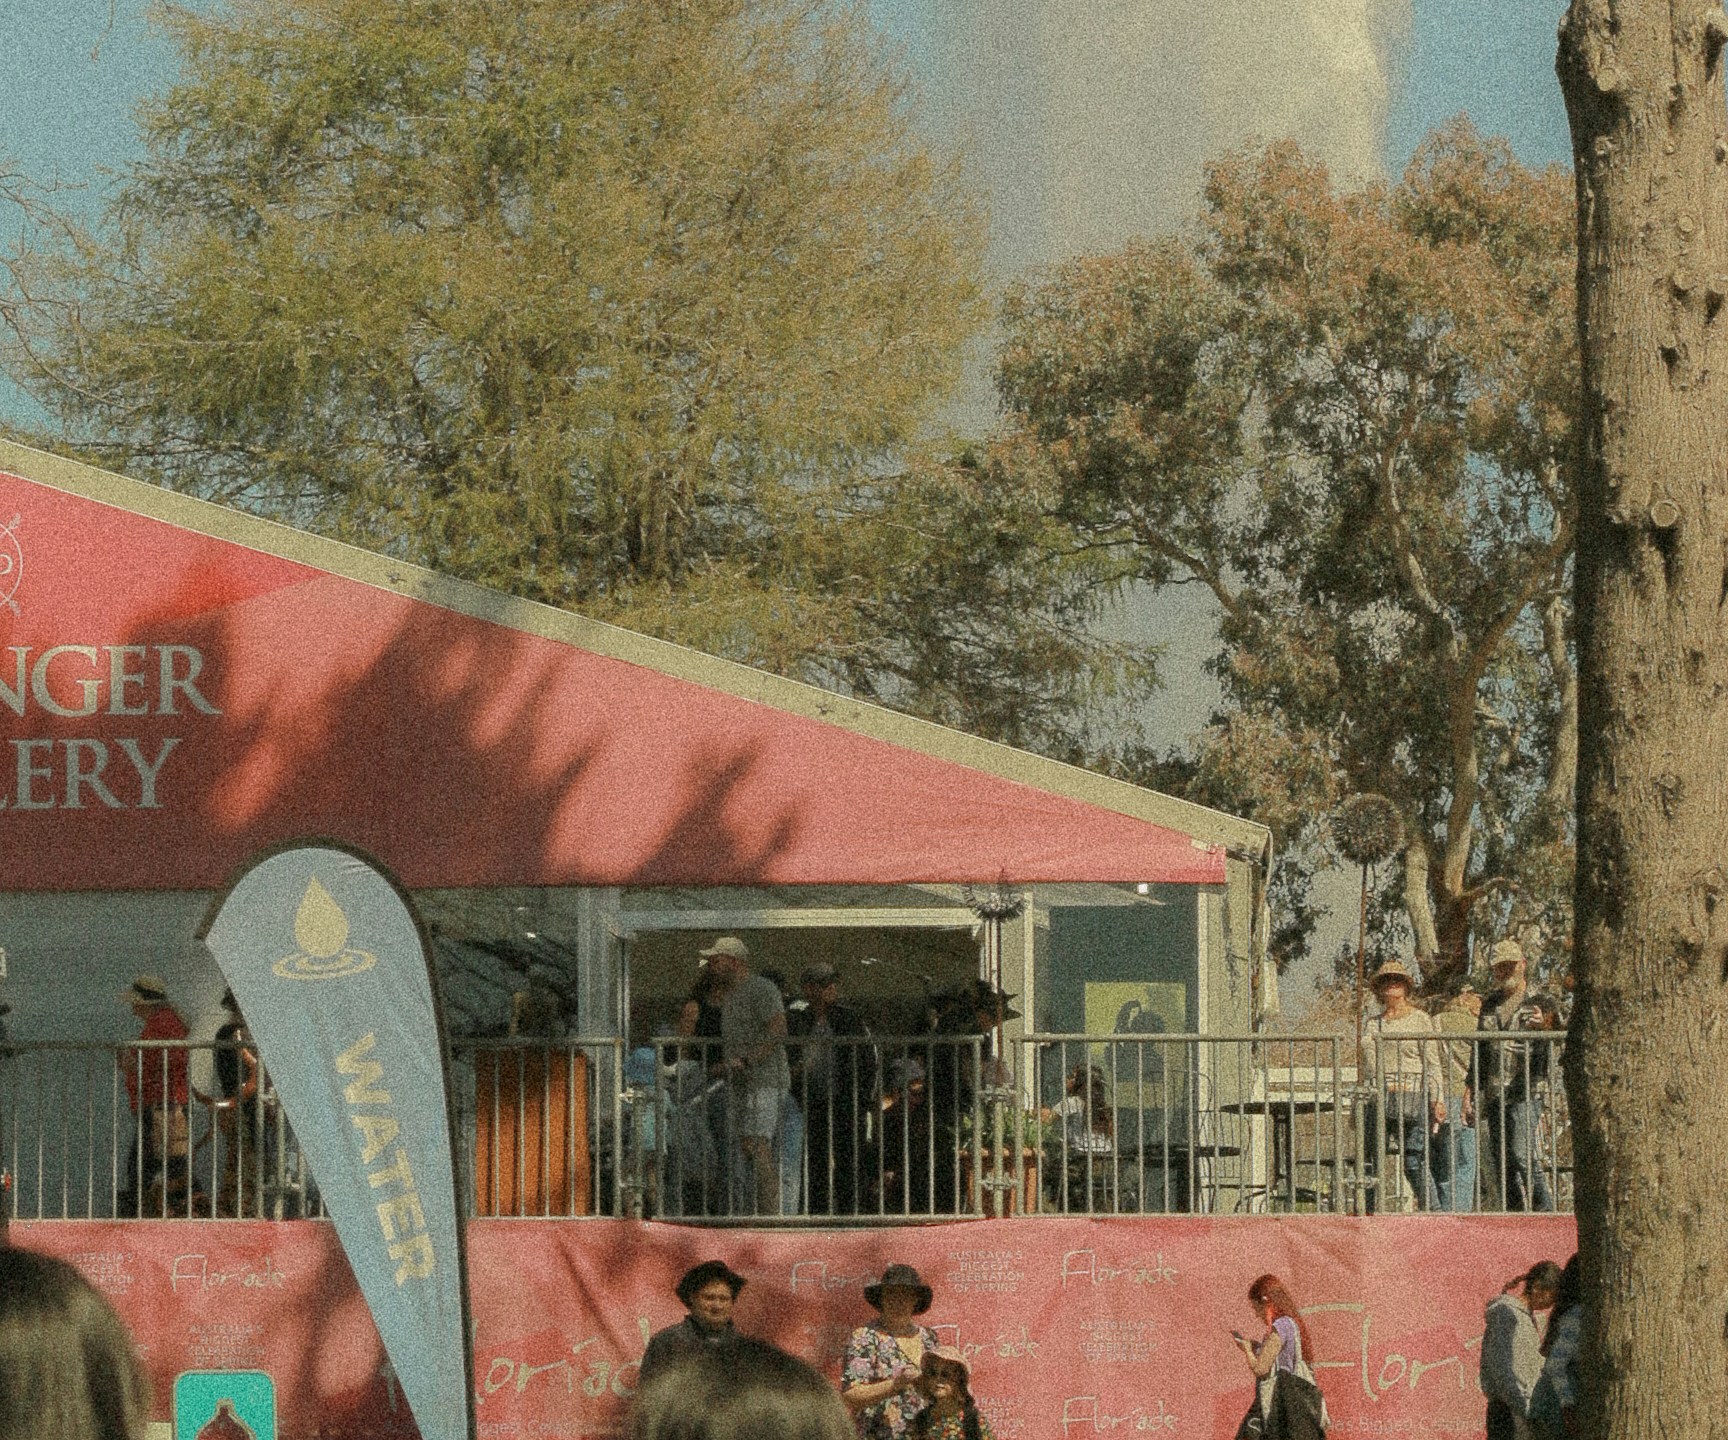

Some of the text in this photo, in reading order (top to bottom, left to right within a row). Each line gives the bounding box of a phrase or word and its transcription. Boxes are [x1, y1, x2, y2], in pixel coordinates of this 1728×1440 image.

[335, 1032, 437, 1288] WATER
[170, 1253, 285, 1292] Floriade
[1061, 1249, 1179, 1289] Floriade
[1061, 1396, 1179, 1437] Floriade
